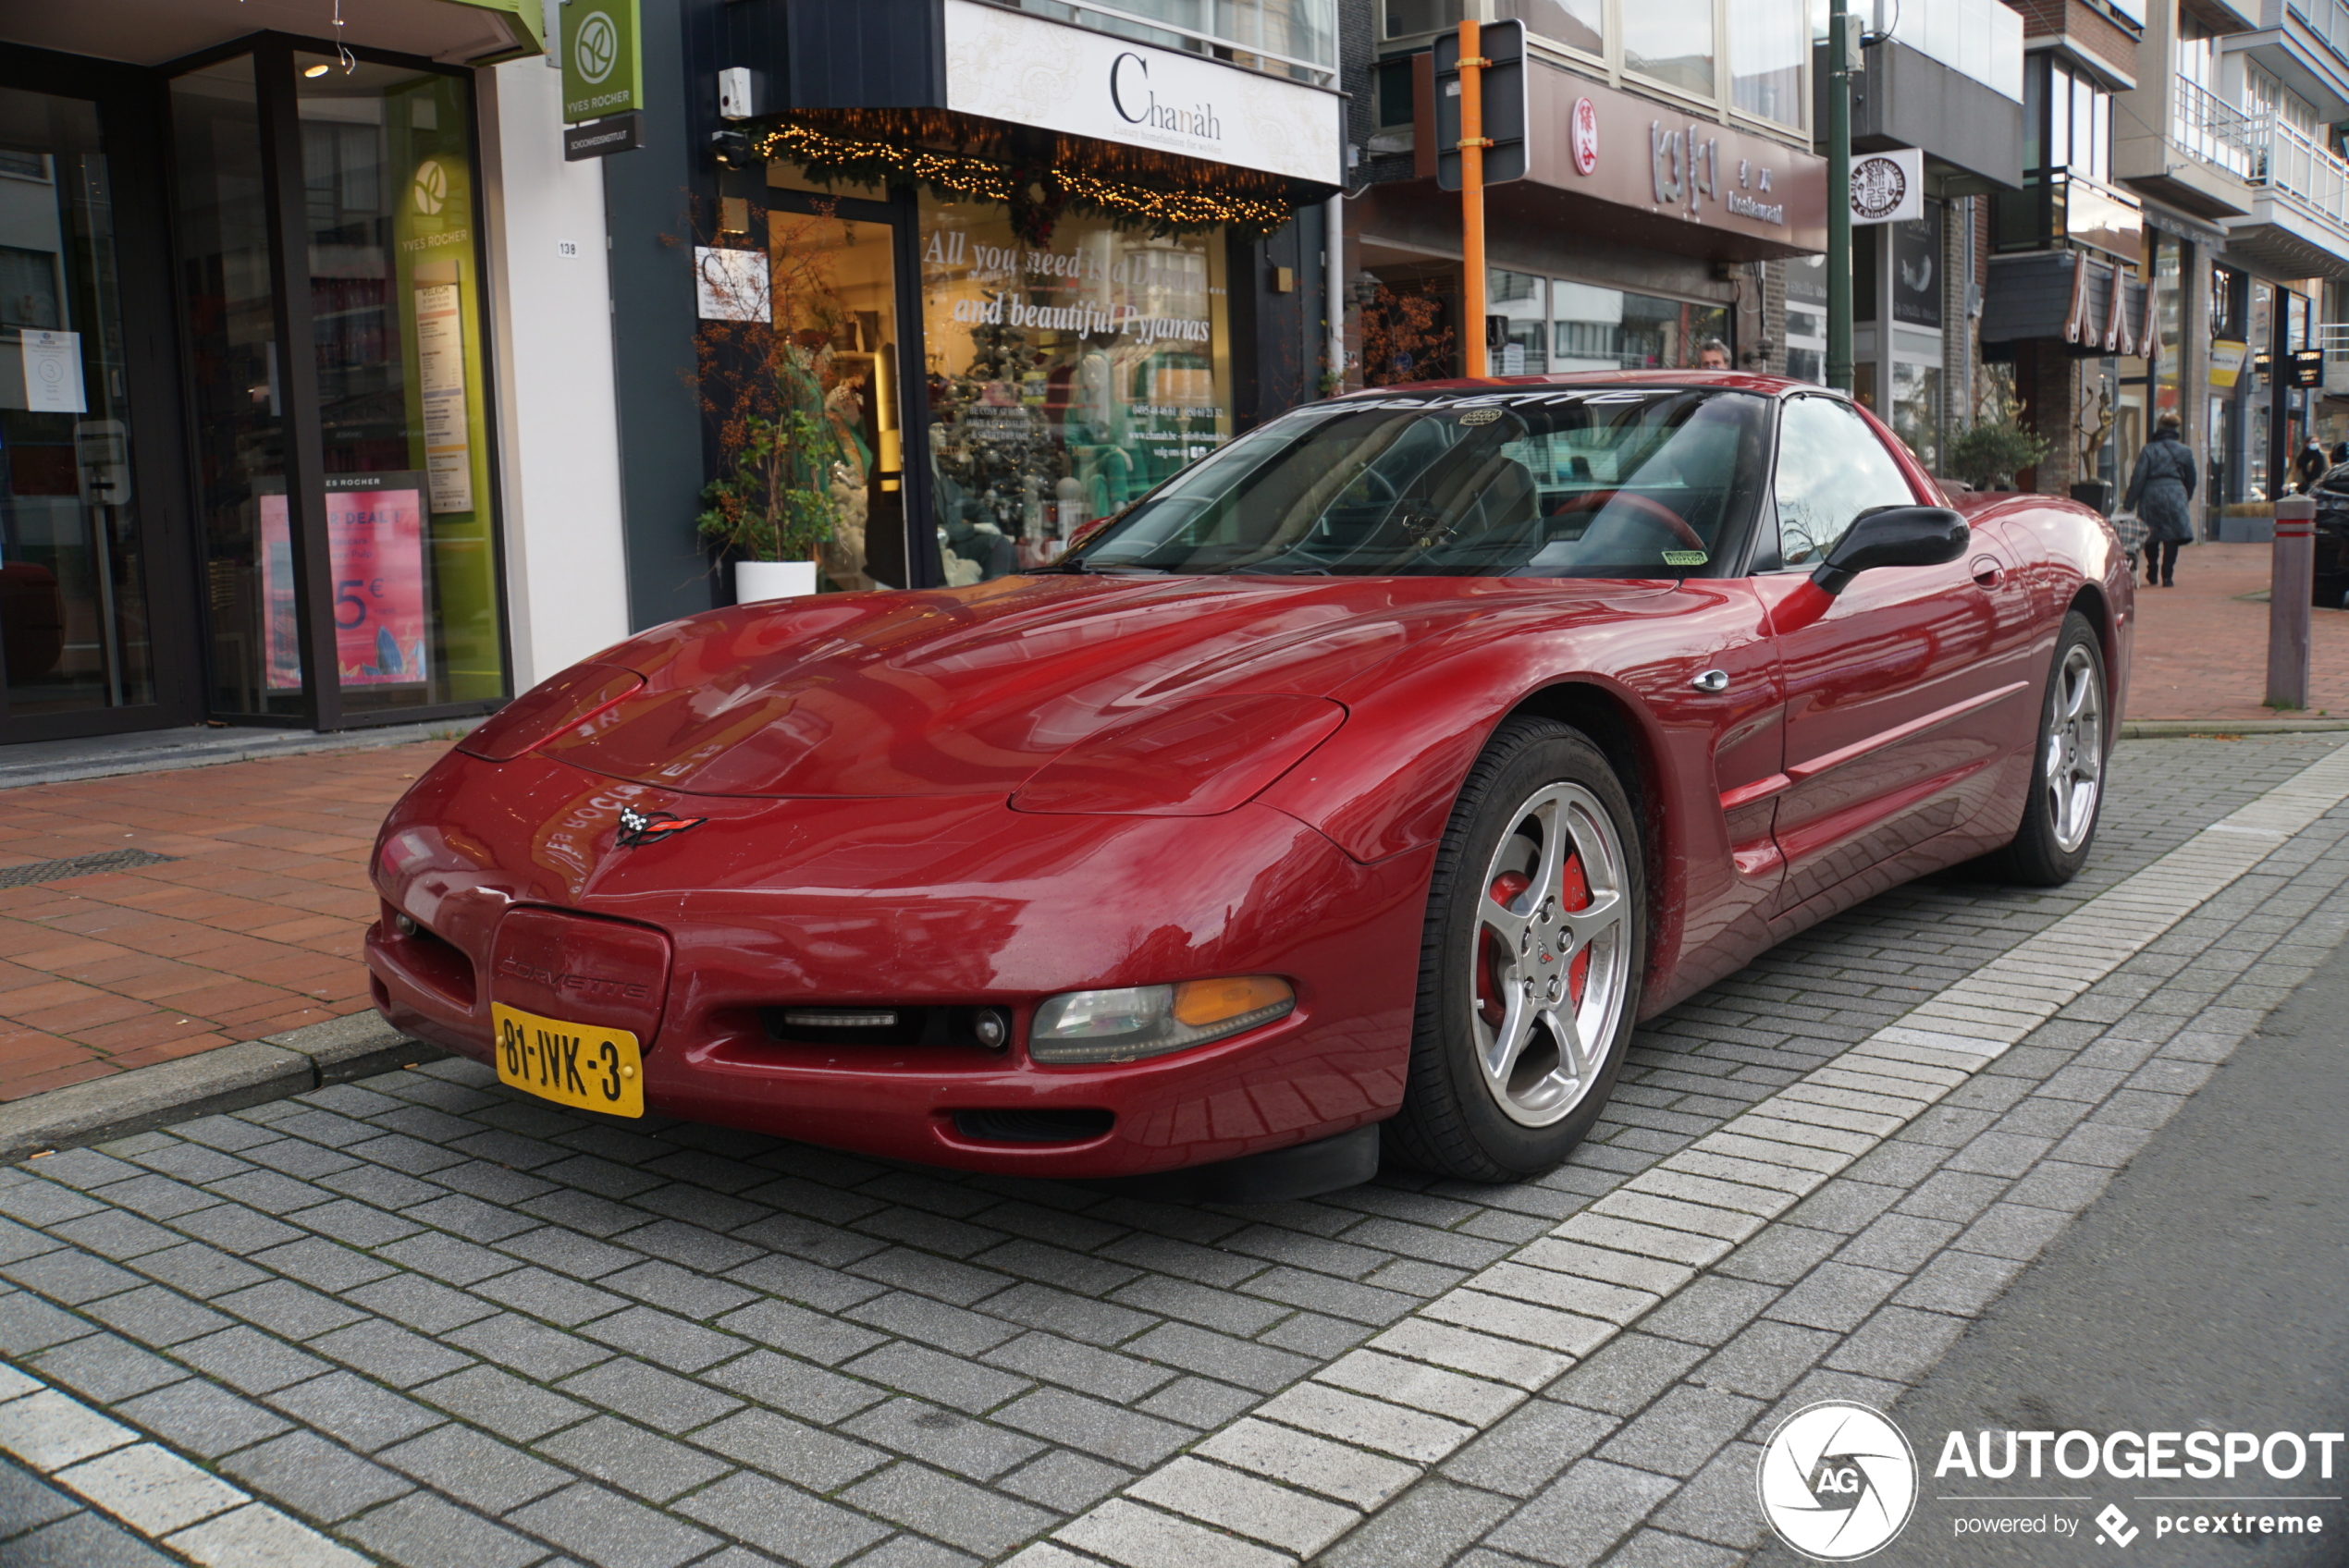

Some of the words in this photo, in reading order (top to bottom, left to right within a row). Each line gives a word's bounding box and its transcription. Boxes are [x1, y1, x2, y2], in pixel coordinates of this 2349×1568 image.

[567, 99, 589, 114] YVES
[591, 90, 630, 110] ROCHER
[1110, 52, 1221, 141] Chanàh
[1113, 124, 1139, 139] Luxury
[1859, 158, 1905, 191] Restaurant
[1728, 190, 1783, 226] Restaurant
[1857, 203, 1896, 218] Chinese
[402, 238, 425, 252] YVES
[427, 229, 468, 248] ROCHER
[560, 242, 576, 255] 138
[924, 230, 965, 265] All
[973, 242, 1016, 273] you
[1026, 247, 1081, 278] need
[954, 292, 1003, 325] and
[1010, 294, 1116, 340] beautiful
[1121, 305, 1210, 345] Pyjamas
[46, 364, 55, 378] 3
[340, 478, 381, 486] ROCHER
[346, 510, 387, 524] DEAL
[498, 957, 648, 999] CORVETTE
[503, 1018, 621, 1102] 81-JVK-3
